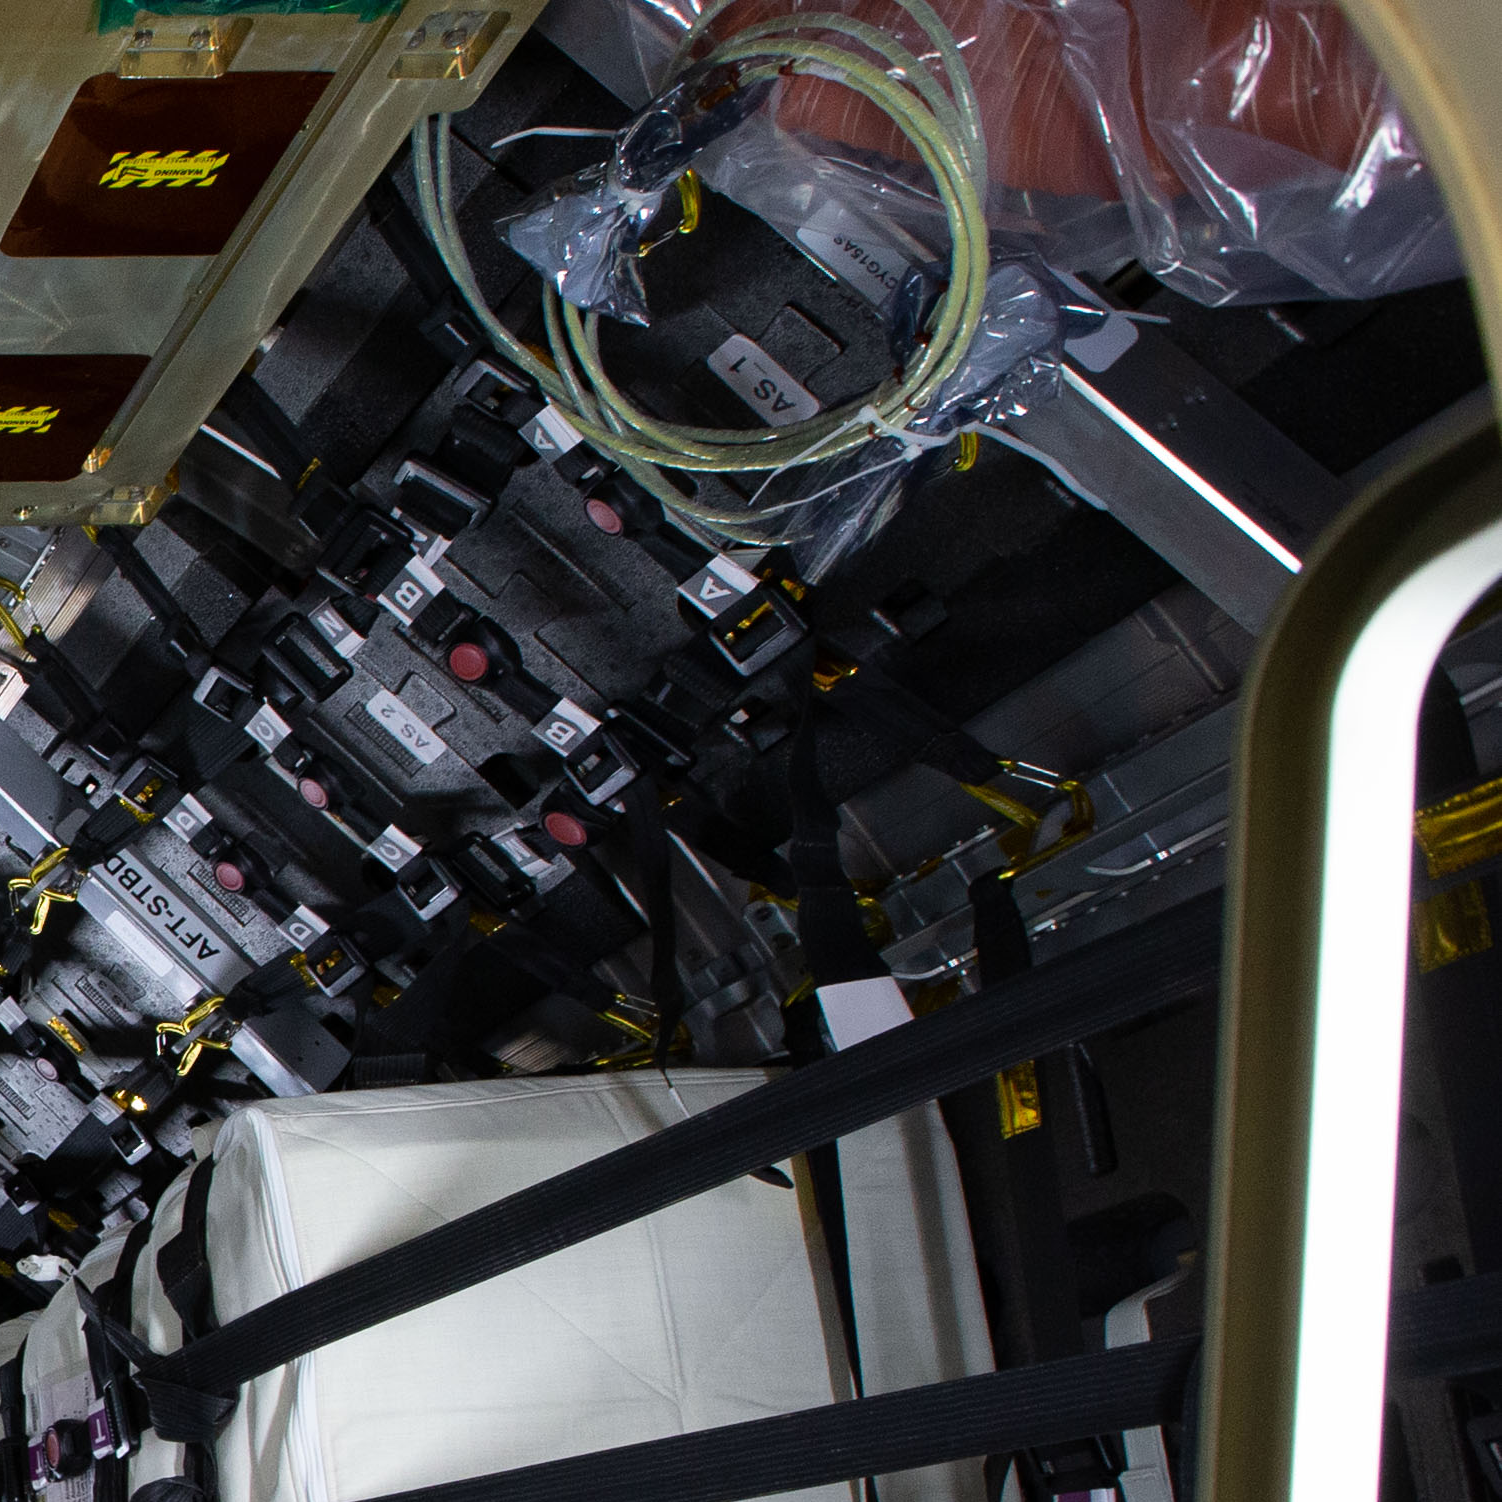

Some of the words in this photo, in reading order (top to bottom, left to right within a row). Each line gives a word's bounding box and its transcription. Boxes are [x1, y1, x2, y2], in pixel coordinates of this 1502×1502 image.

[154, 168, 203, 177] WARNING
[725, 355, 795, 416] AS_1
[532, 428, 557, 451] A
[395, 581, 424, 608] B
[698, 581, 731, 602] A
[253, 719, 276, 741] C
[546, 725, 578, 745] B
[174, 808, 197, 831] D
[383, 840, 407, 860] C
[104, 855, 221, 961] AFT-STBD
[289, 921, 313, 941] D
[95, 1418, 106, 1443] T
[36, 1451, 44, 1475] T
